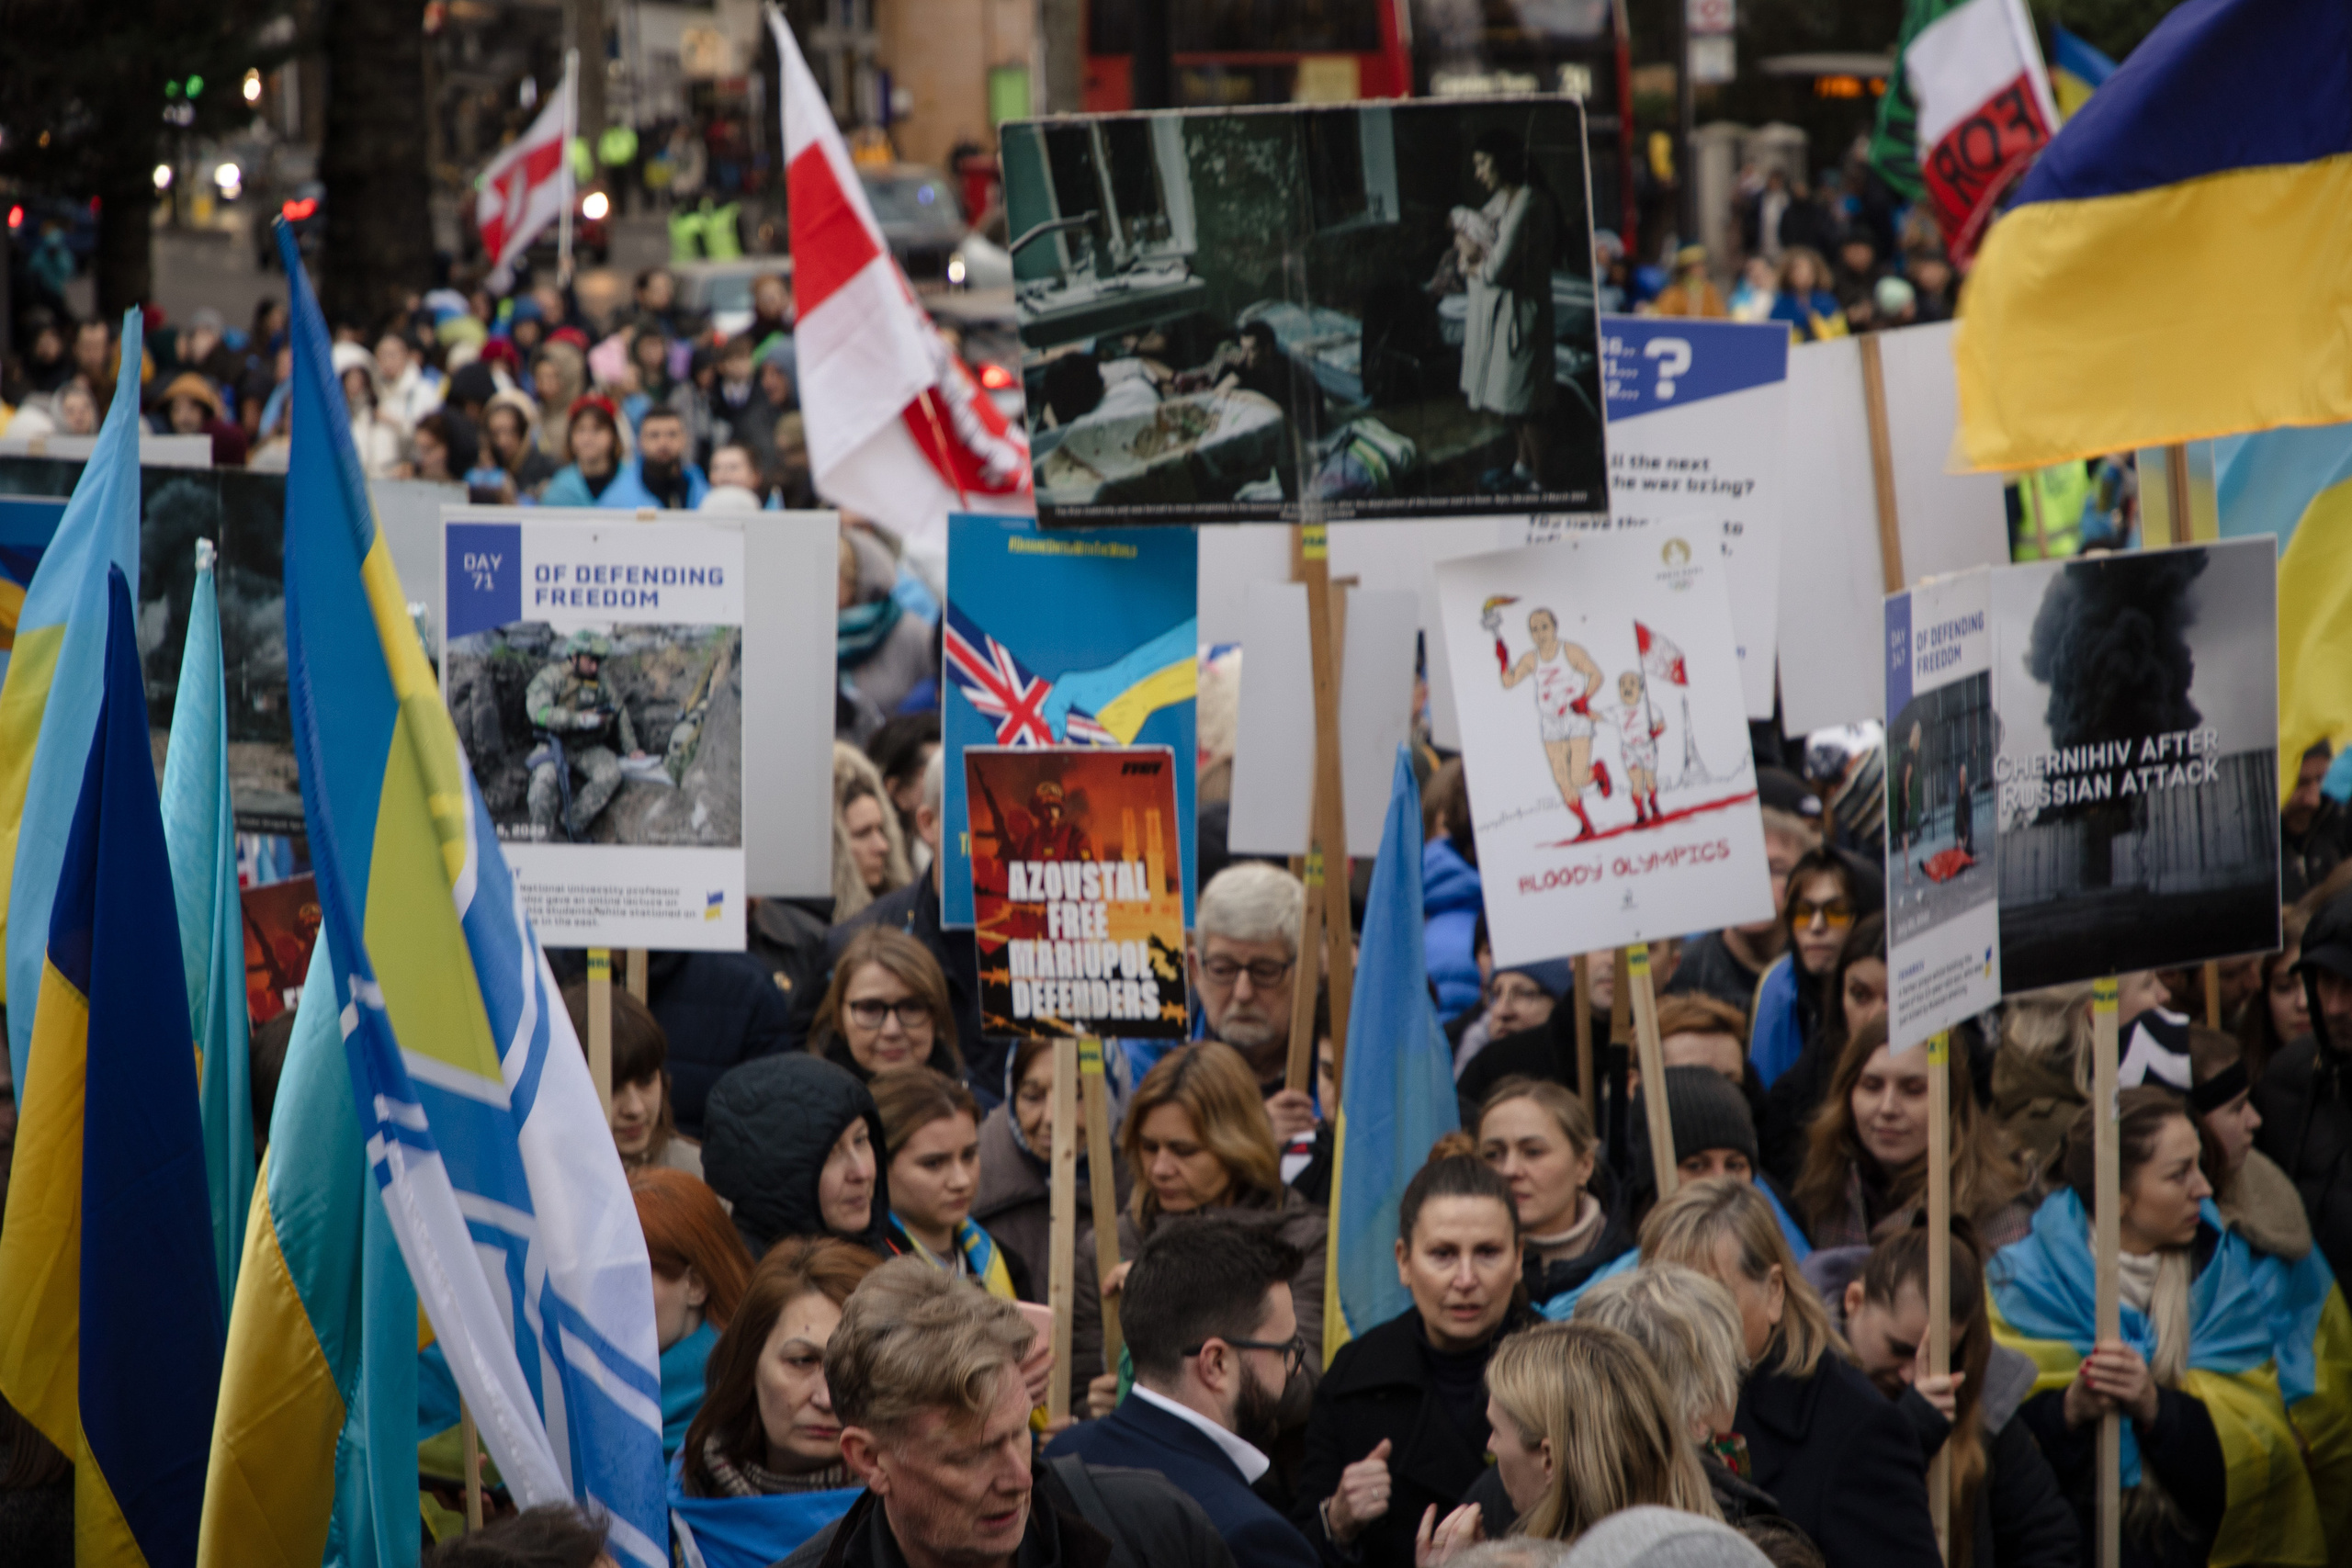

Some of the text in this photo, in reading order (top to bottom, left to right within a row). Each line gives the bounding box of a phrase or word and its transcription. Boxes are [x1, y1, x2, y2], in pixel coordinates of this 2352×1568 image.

[1612, 474, 1635, 491] he
[1667, 457, 1709, 471] next
[464, 552, 503, 572] DAY
[471, 571, 494, 591] 71
[535, 564, 724, 586] OF DEFENDING
[535, 587, 660, 608] FREEDOM
[1917, 610, 1984, 652] OF DEFENDING
[1917, 643, 1962, 678] FREEDOM
[1994, 728, 2219, 783] CHERNIHIV AFTER
[2001, 758, 2219, 811] RUSSIAN ATTACK
[1008, 861, 1150, 902] AZOVSTAL
[1518, 837, 1731, 897] BLOODY OLYMPICS
[1047, 900, 1109, 940] FREE
[1008, 939, 1154, 979] MARIUPOL
[1011, 979, 1160, 1021] DEFENDERS
